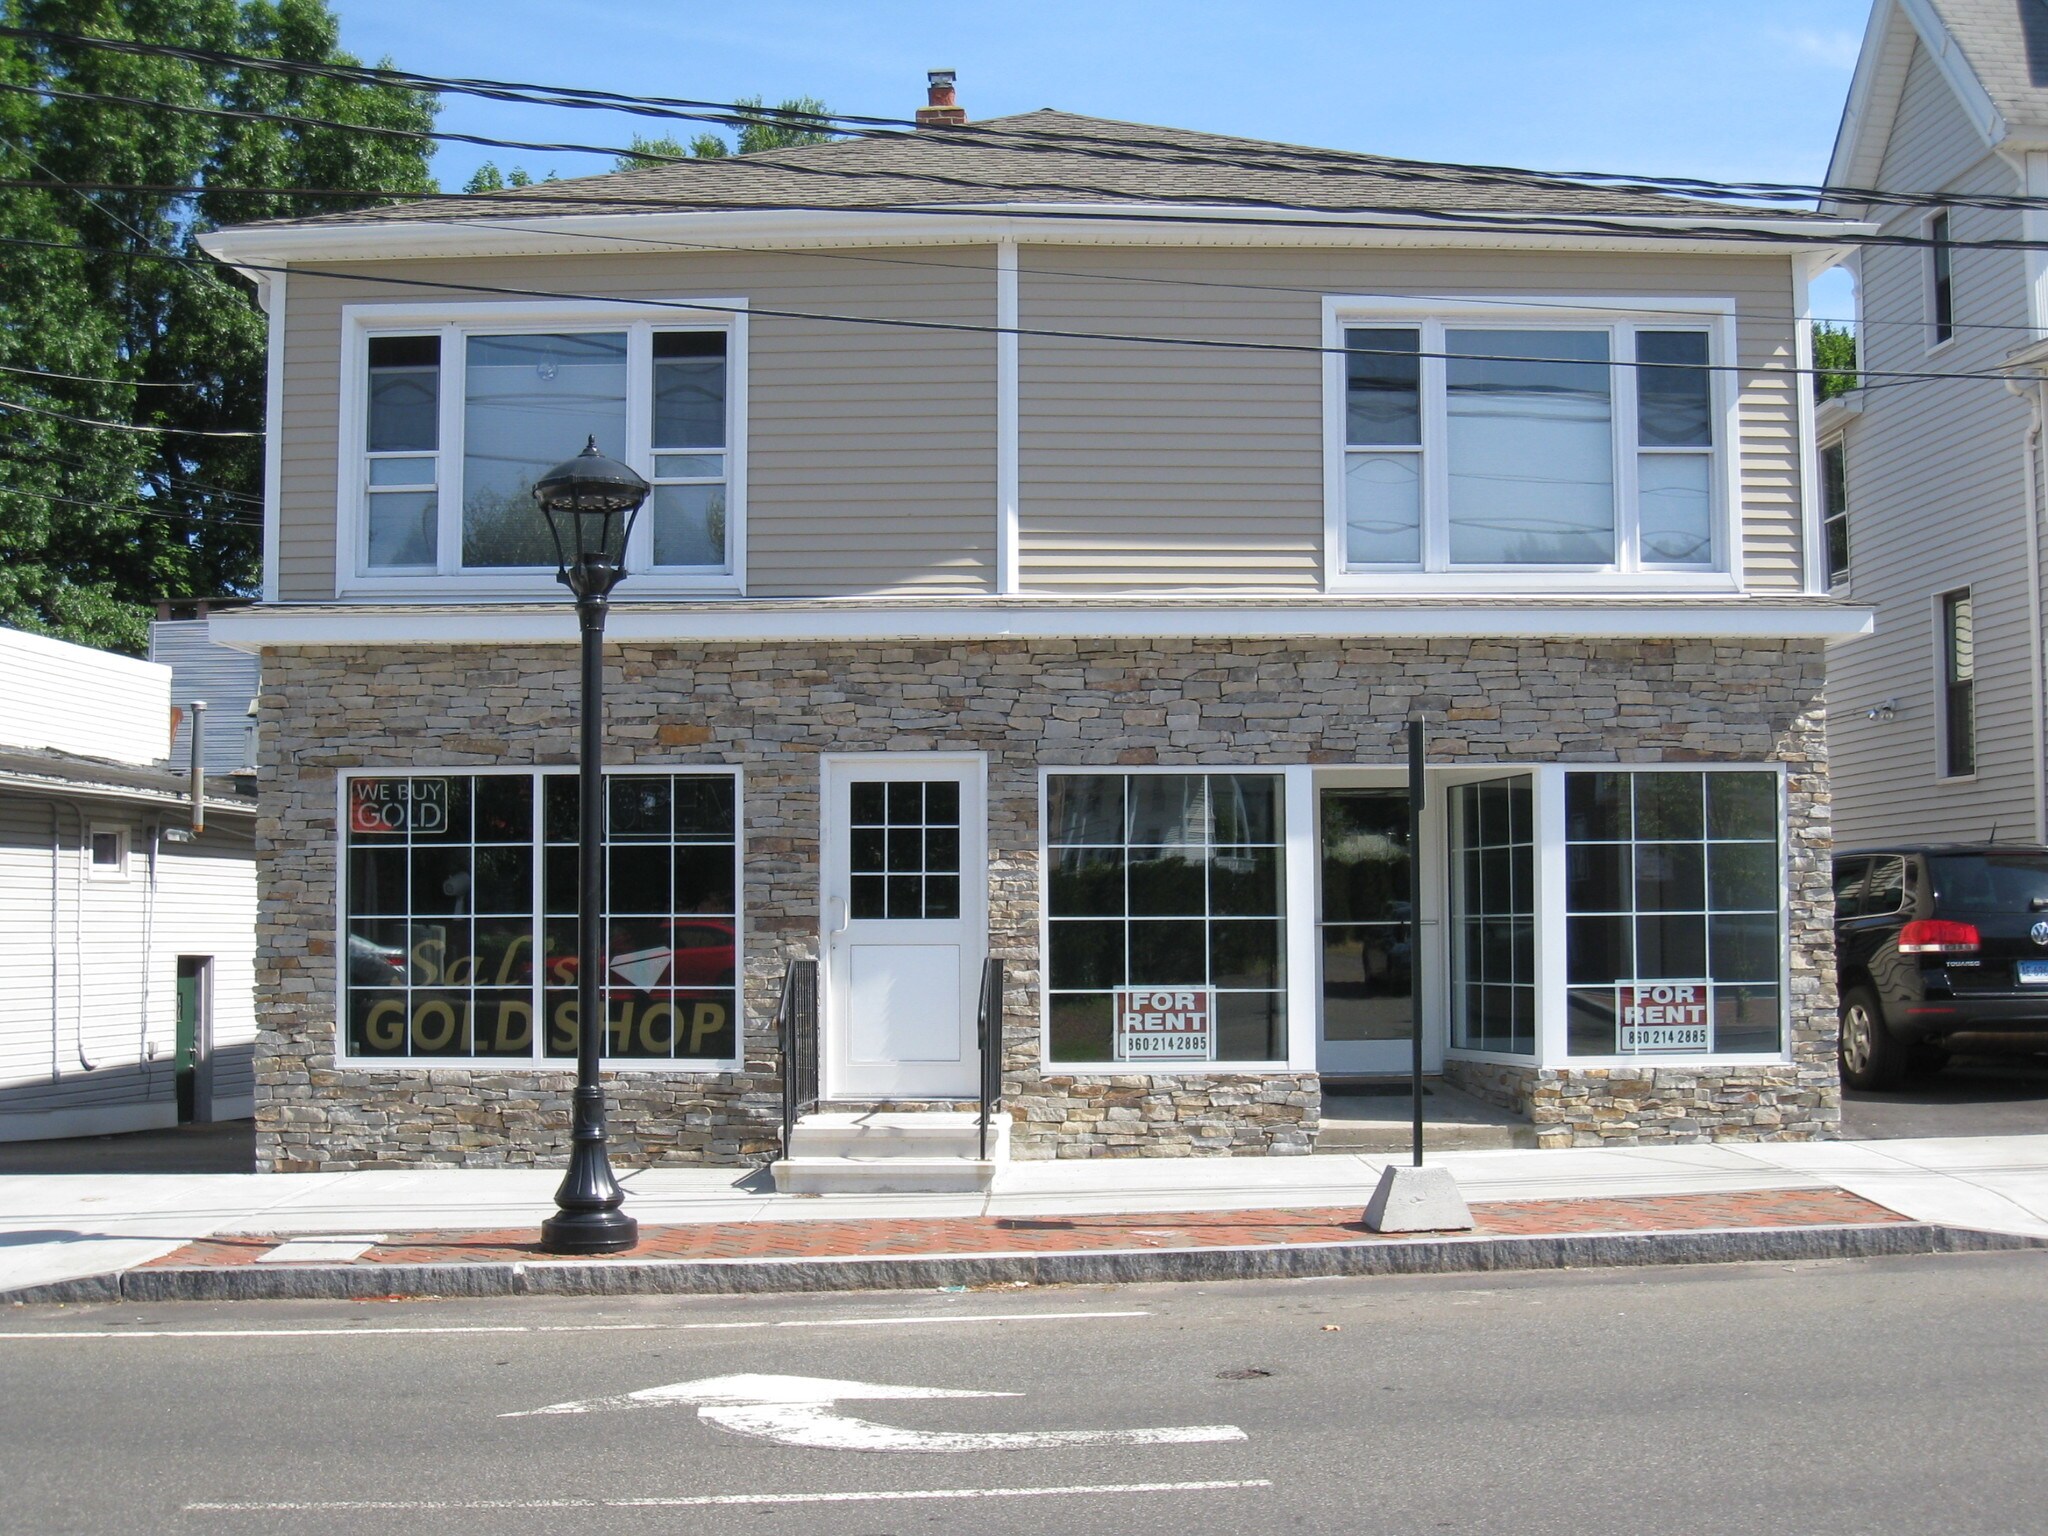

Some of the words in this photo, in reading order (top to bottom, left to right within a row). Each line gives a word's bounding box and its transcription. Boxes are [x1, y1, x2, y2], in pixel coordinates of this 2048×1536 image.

[357, 784, 390, 800] WE
[397, 784, 441, 800] BUY
[357, 802, 441, 827] GOLD
[1132, 992, 1196, 1010] FOR
[1635, 986, 1695, 1004] FOR
[1122, 1012, 1207, 1031] RENT
[1624, 1005, 1706, 1024] RENT
[366, 1000, 534, 1051] GOLD
[551, 1000, 726, 1053] SHOP
